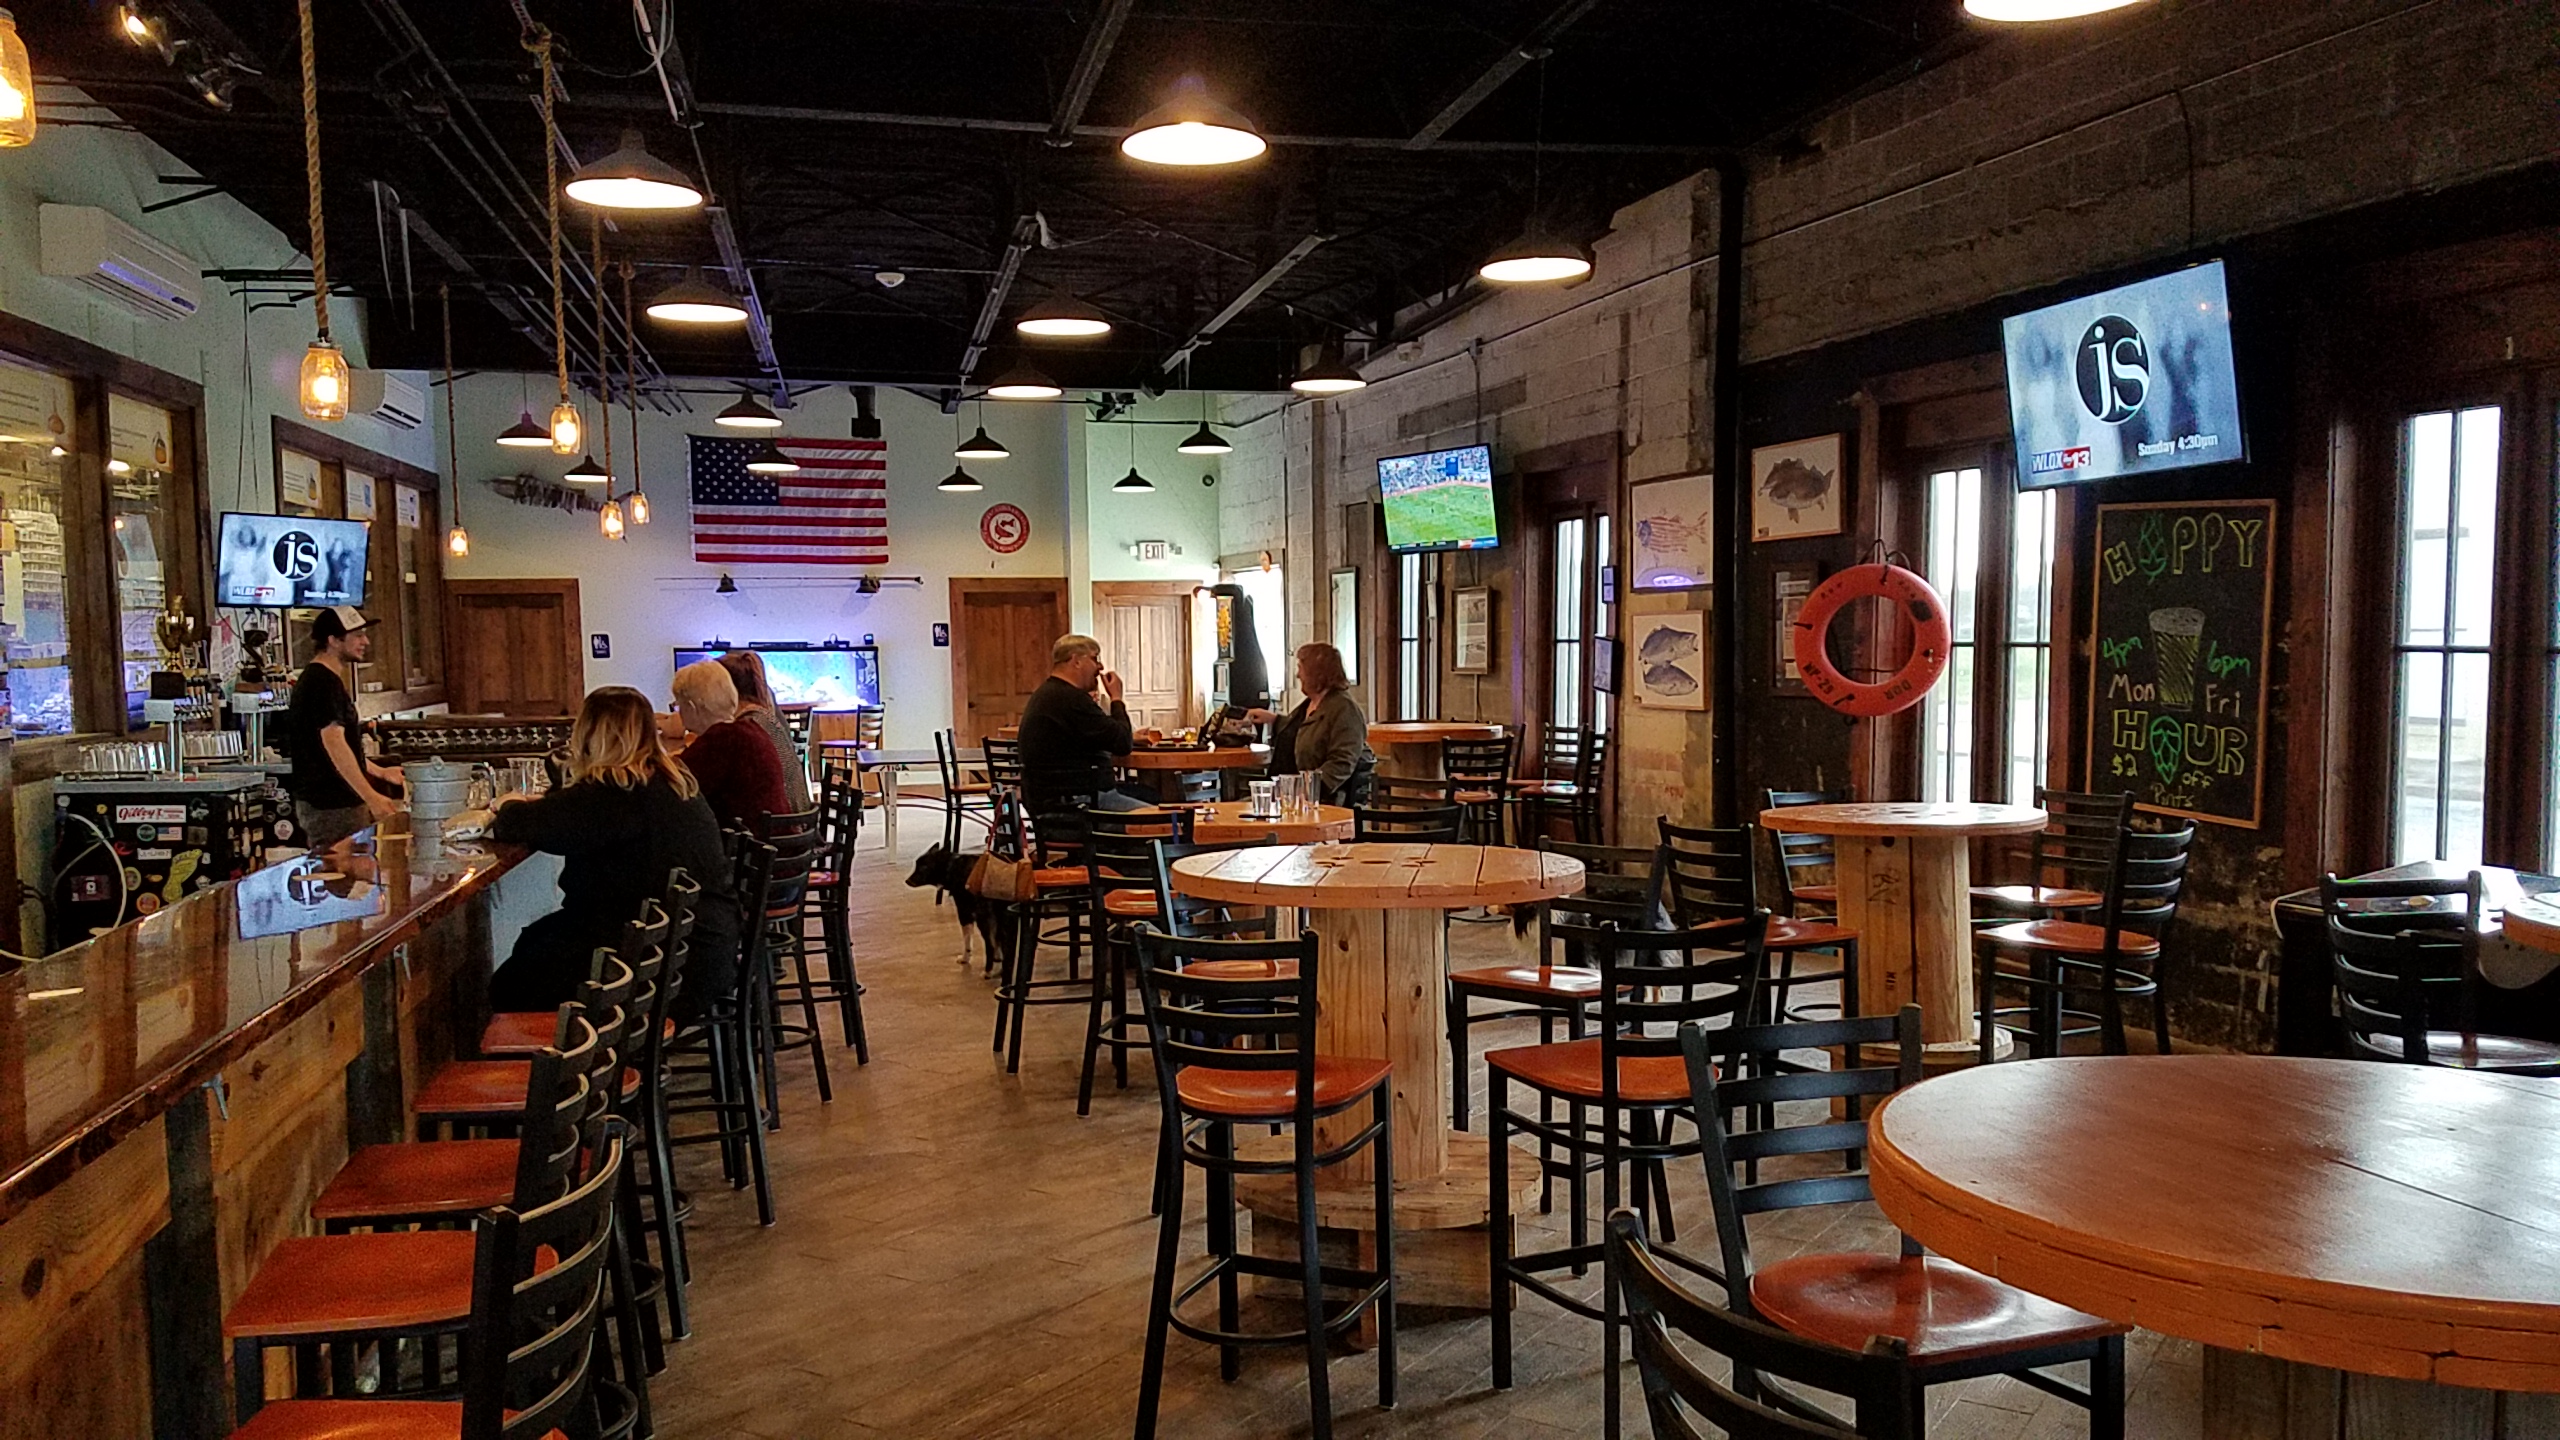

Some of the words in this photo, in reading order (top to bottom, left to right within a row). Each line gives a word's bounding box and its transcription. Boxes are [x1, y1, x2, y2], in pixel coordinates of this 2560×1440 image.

[2088, 325, 2149, 420] js
[2071, 451, 2090, 468] 13
[2138, 440, 2175, 456] Sunday
[2178, 434, 2218, 450] 4:30pm
[284, 534, 318, 578] js
[1145, 544, 1165, 559] EXIT
[2207, 640, 2250, 678] 6pm
[2108, 673, 2155, 702] Mon
[2206, 683, 2240, 718] Fri
[2112, 752, 2138, 776] $2
